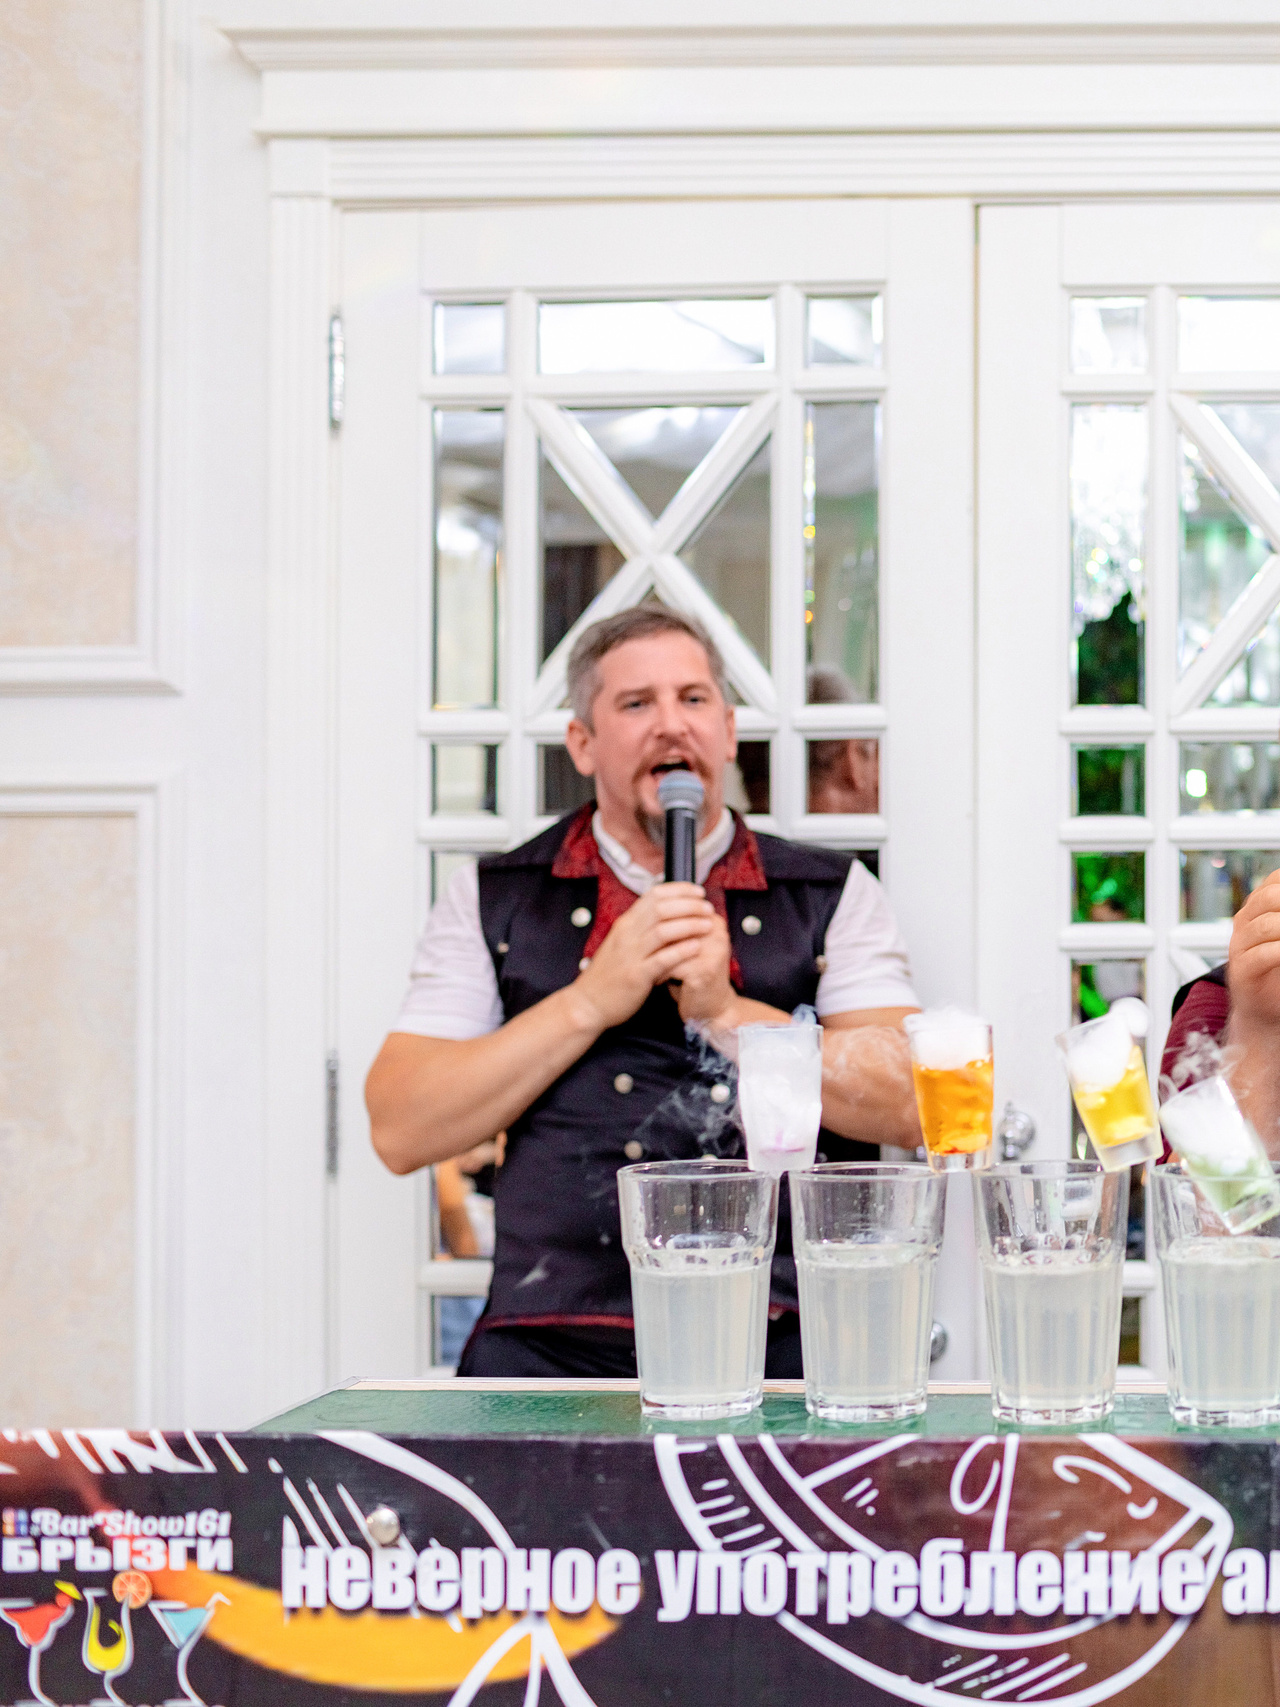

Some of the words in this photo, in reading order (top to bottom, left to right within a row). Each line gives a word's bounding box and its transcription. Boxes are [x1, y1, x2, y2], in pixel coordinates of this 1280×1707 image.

[2, 1537, 233, 1572] БРЫЗГИ
[282, 1545, 641, 1619] неверное
[654, 1537, 1207, 1624] употребление
